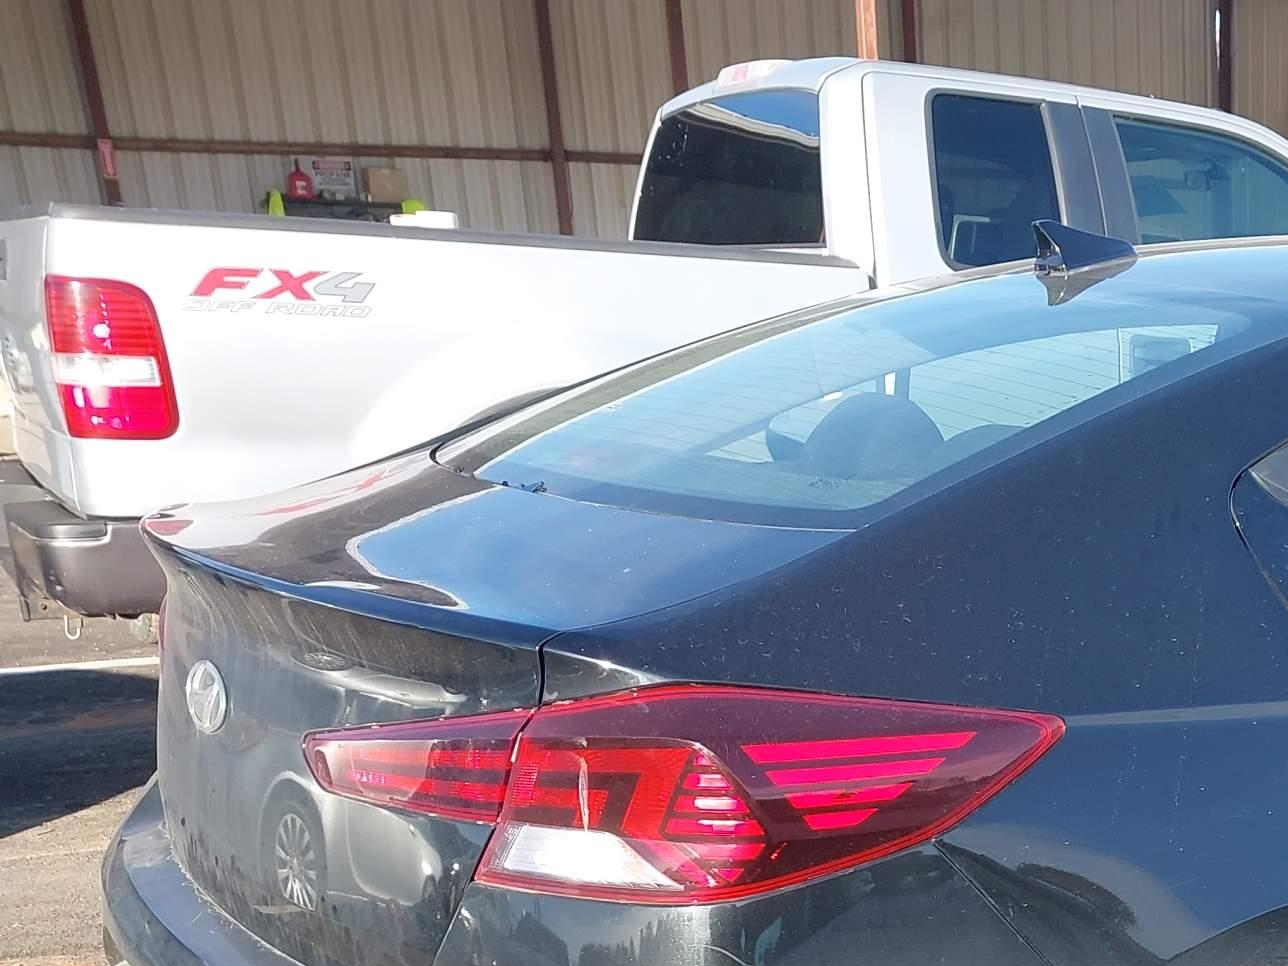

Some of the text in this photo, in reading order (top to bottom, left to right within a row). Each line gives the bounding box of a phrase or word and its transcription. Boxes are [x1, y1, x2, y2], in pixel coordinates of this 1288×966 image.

[189, 266, 376, 303] FX4
[182, 300, 372, 318] OFF ROAD
